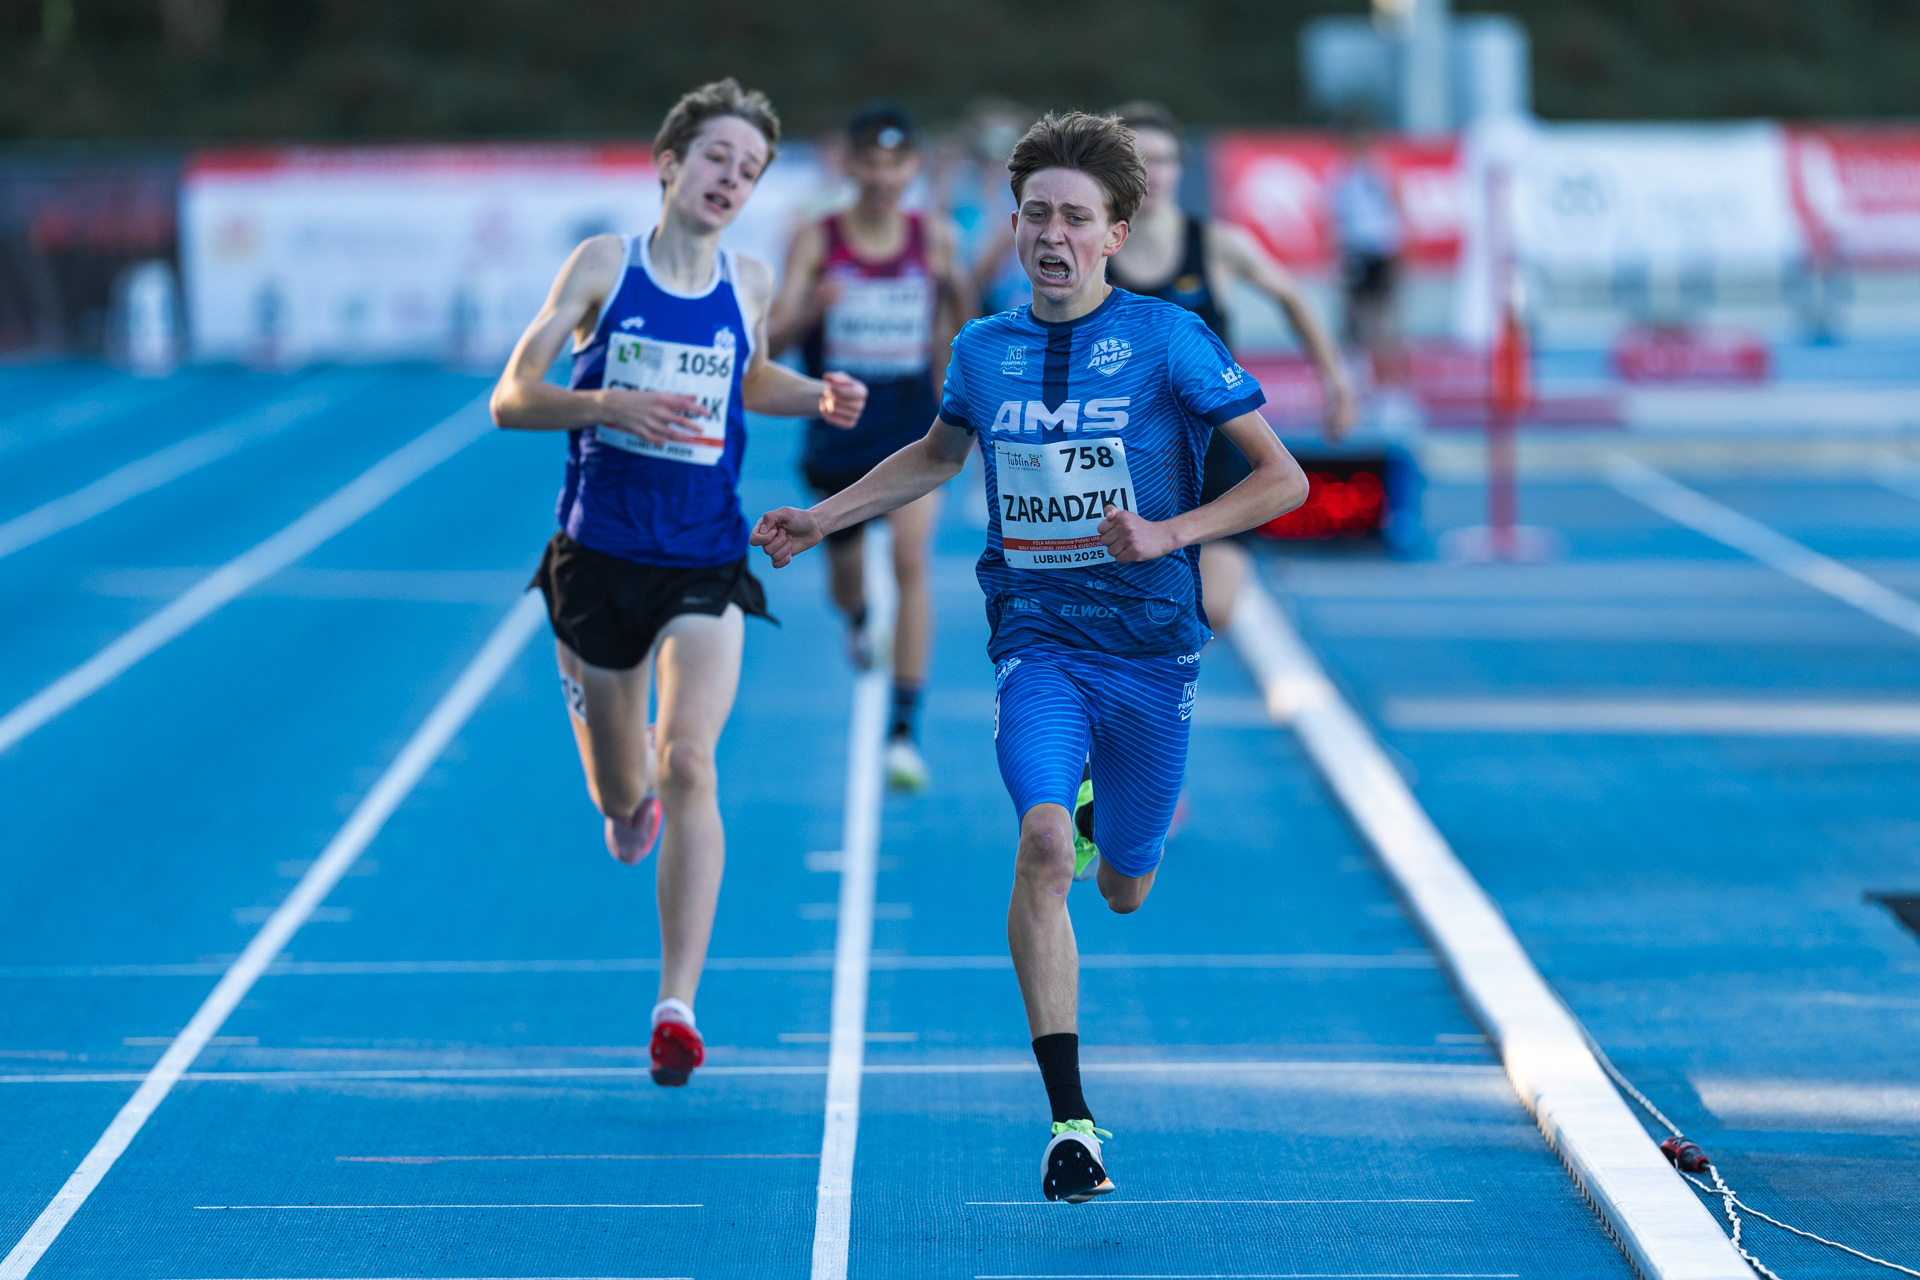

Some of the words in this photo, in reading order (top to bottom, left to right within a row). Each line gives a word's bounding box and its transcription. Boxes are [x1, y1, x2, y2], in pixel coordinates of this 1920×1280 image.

[677, 351, 731, 379] 1056
[1010, 348, 1022, 360] KB
[1087, 348, 1132, 370] AMS
[991, 397, 1131, 433] AMS
[1059, 445, 1115, 473] 758
[1003, 488, 1129, 523] ZARADZKI
[1033, 554, 1072, 564] LUBLIN
[1074, 550, 1105, 562] 2025
[1060, 604, 1119, 618] ELWOZ
